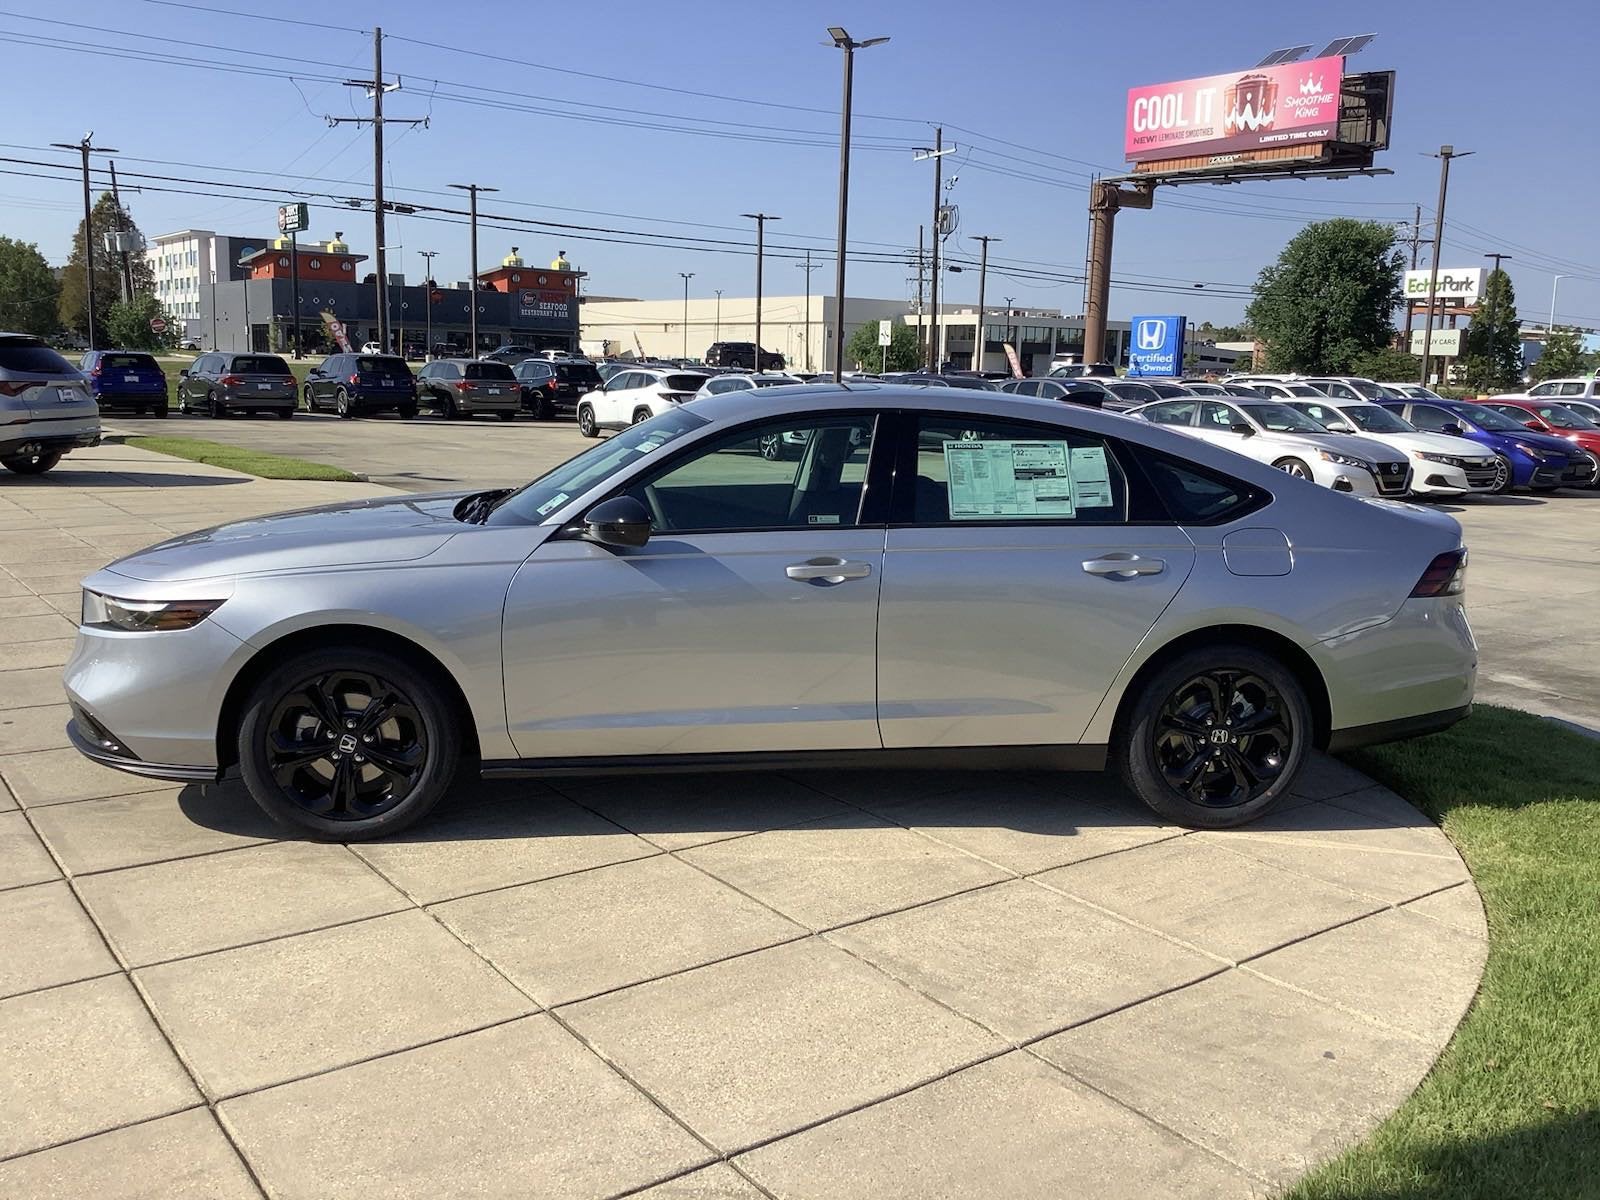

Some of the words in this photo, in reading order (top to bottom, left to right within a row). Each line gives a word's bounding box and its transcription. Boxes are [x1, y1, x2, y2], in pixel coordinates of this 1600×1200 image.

[1284, 93, 1335, 108] SMOOTHIE
[1133, 93, 1188, 132] COOL
[1195, 87, 1217, 124] IT
[1133, 135, 1158, 144] NEW!
[1159, 130, 1185, 141] LEMONADE
[1185, 128, 1214, 138] SMOOTHIES
[1259, 134, 1289, 143] LIMITED
[1289, 131, 1307, 139] TIME
[539, 302, 567, 310] SEAFOOD
[1129, 353, 1173, 363] Certified
[1129, 363, 1172, 372] P-Owned
